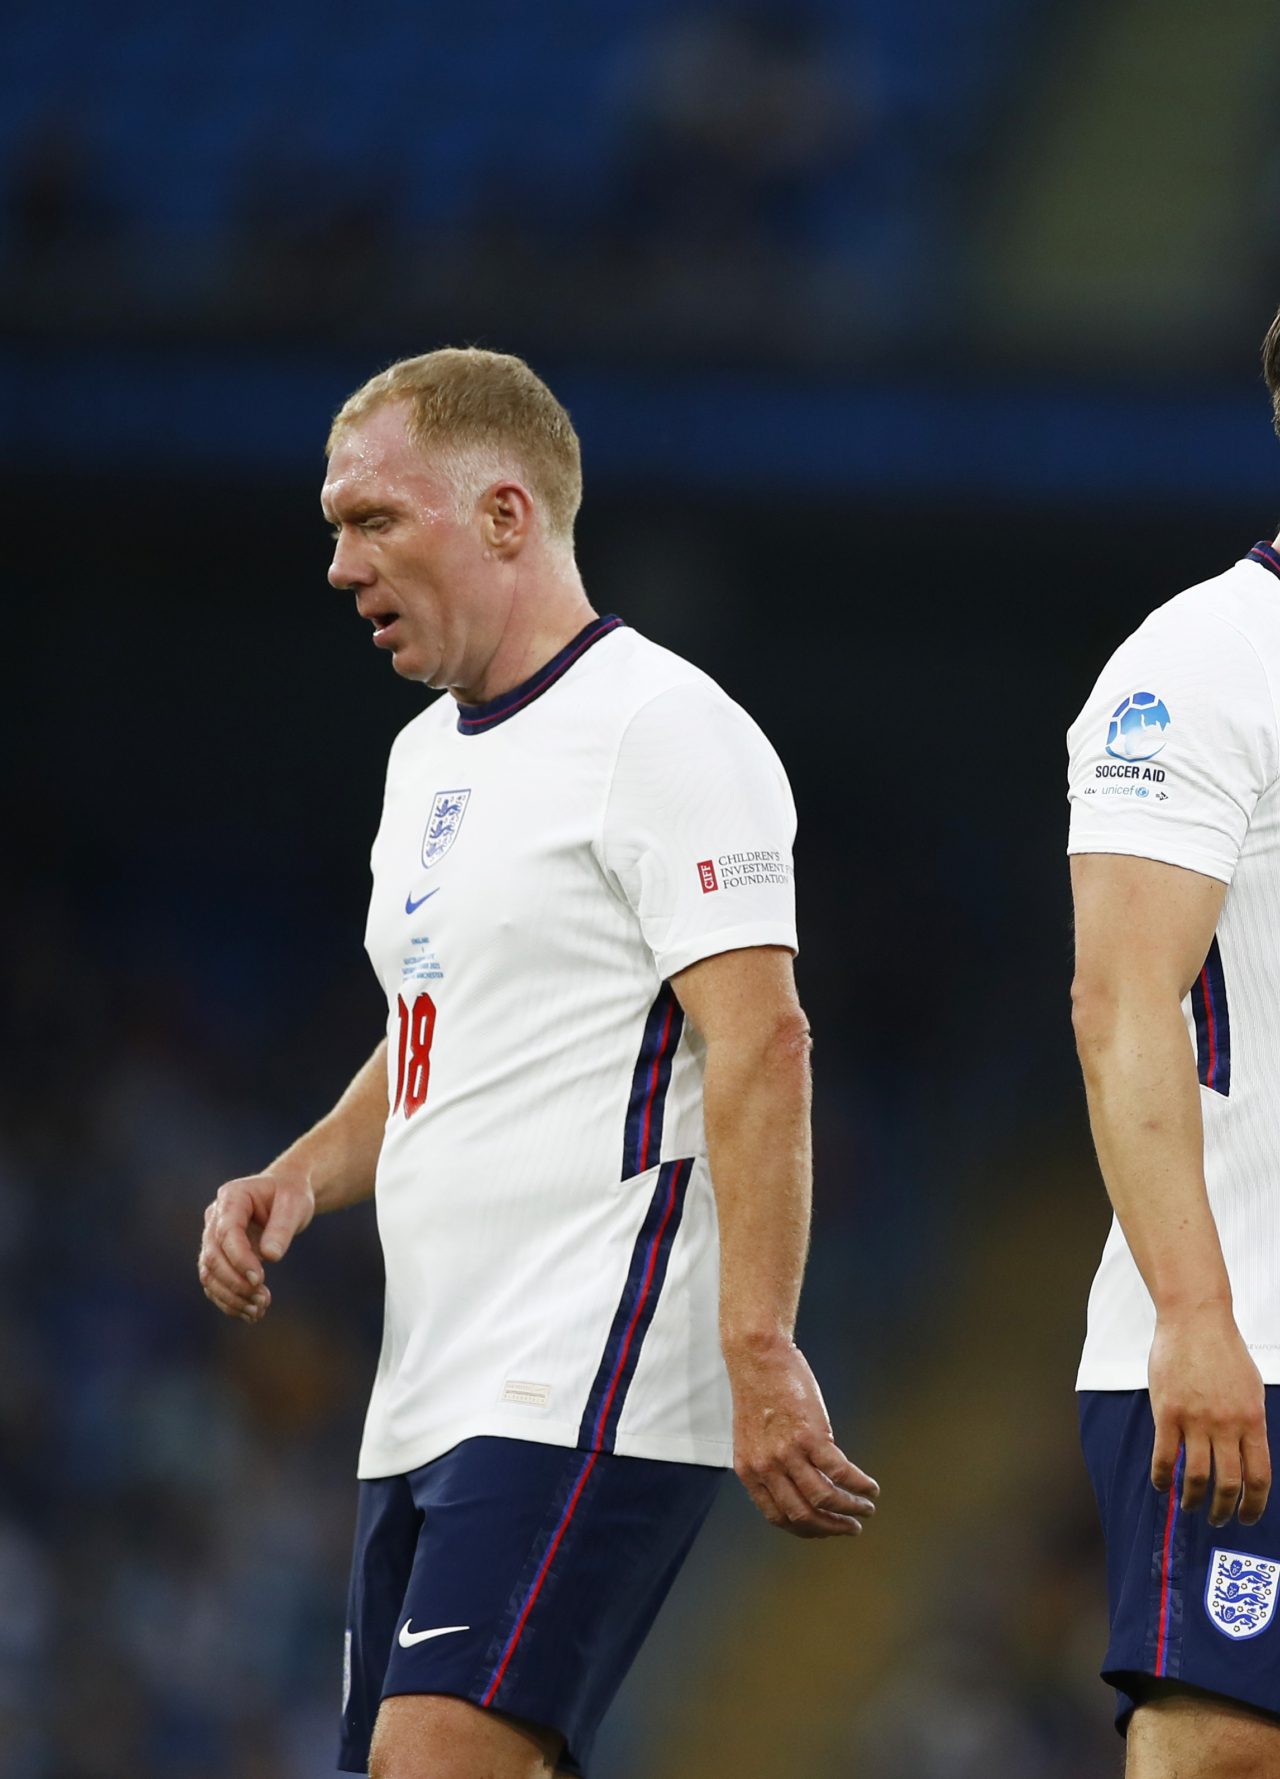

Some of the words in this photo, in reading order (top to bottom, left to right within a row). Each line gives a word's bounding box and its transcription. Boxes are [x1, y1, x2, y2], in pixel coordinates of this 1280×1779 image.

[1095, 765, 1140, 779] SOCCER
[1141, 768, 1166, 783] AID
[1101, 784, 1135, 795] unicef
[718, 851, 780, 866] CHILDREN'S
[700, 864, 715, 890] CIFF
[720, 863, 784, 877] INVESTMENT
[723, 874, 788, 889] FOUNDATION
[392, 992, 437, 1120] 18
